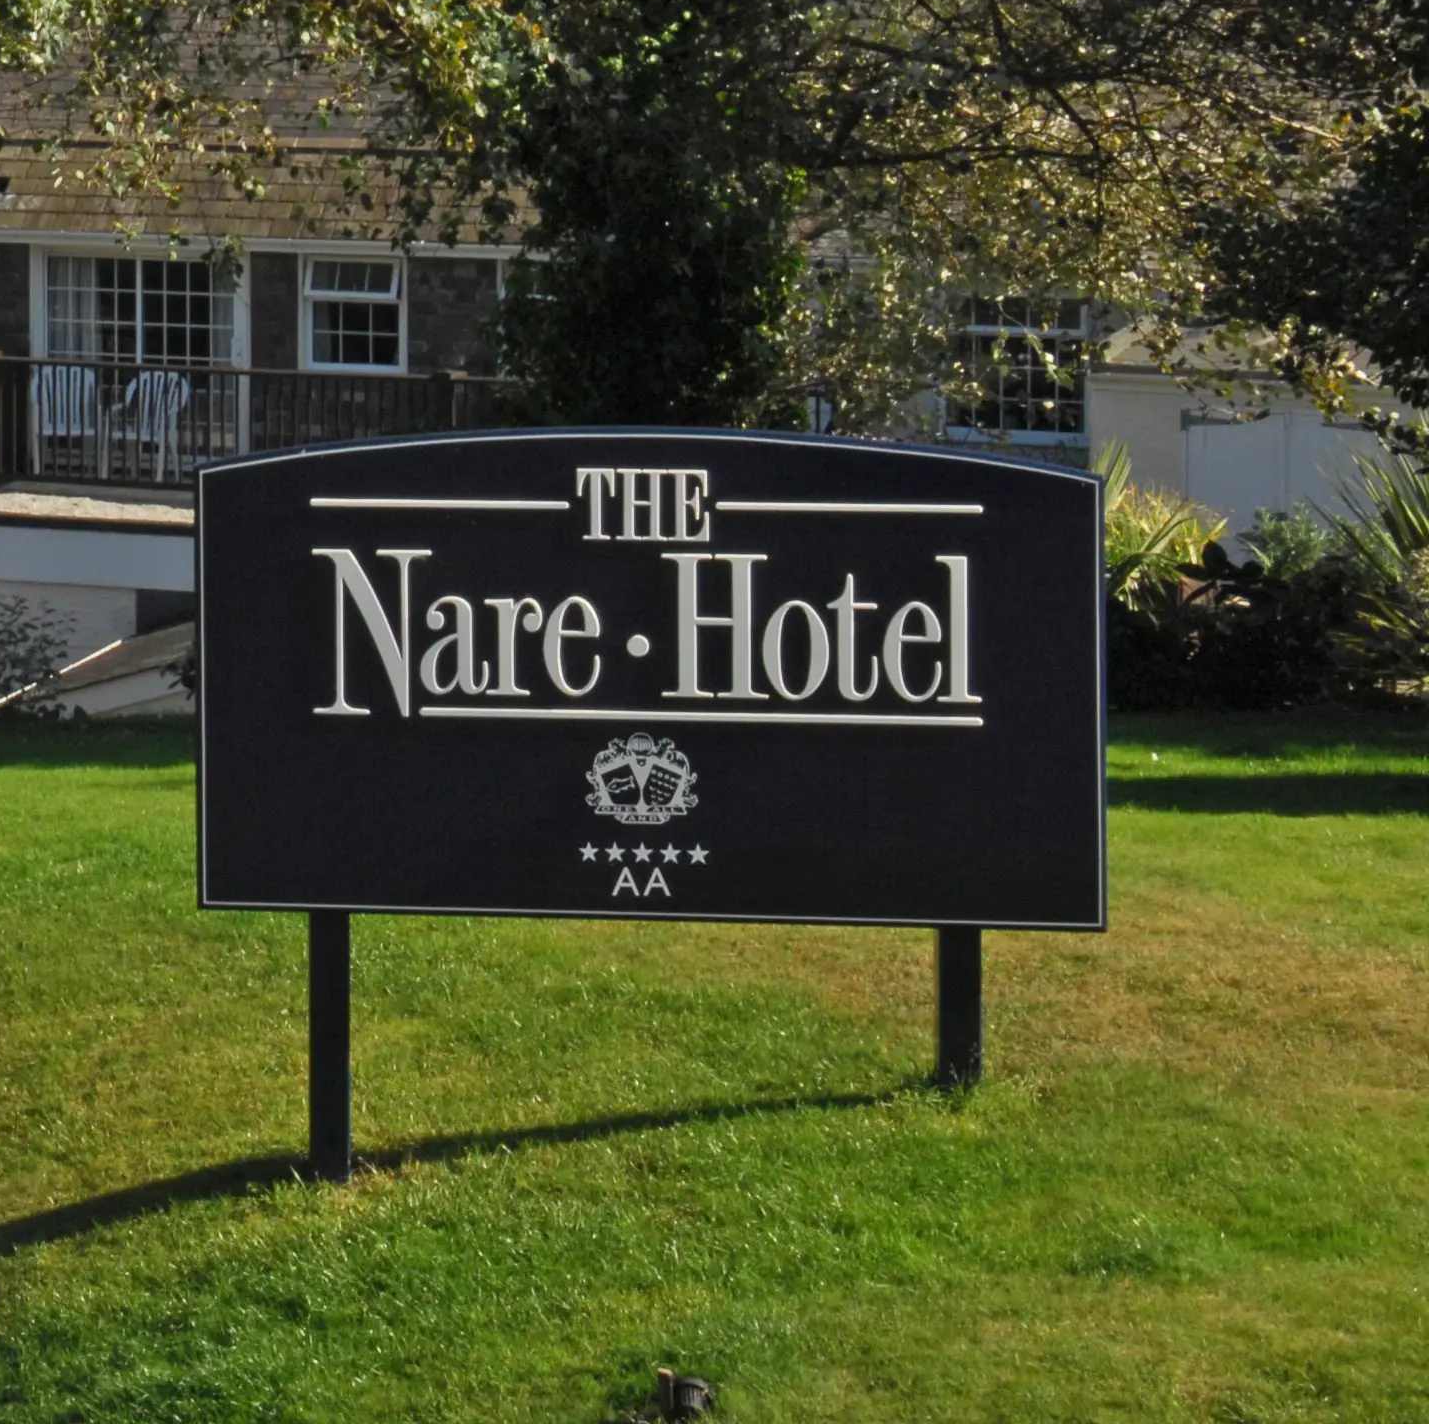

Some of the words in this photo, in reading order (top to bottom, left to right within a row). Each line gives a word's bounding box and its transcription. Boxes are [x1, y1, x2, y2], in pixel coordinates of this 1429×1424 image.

[576, 468, 710, 542] THE
[311, 548, 602, 718] Nare
[661, 553, 982, 703] Hotel
[612, 866, 671, 897] AA
